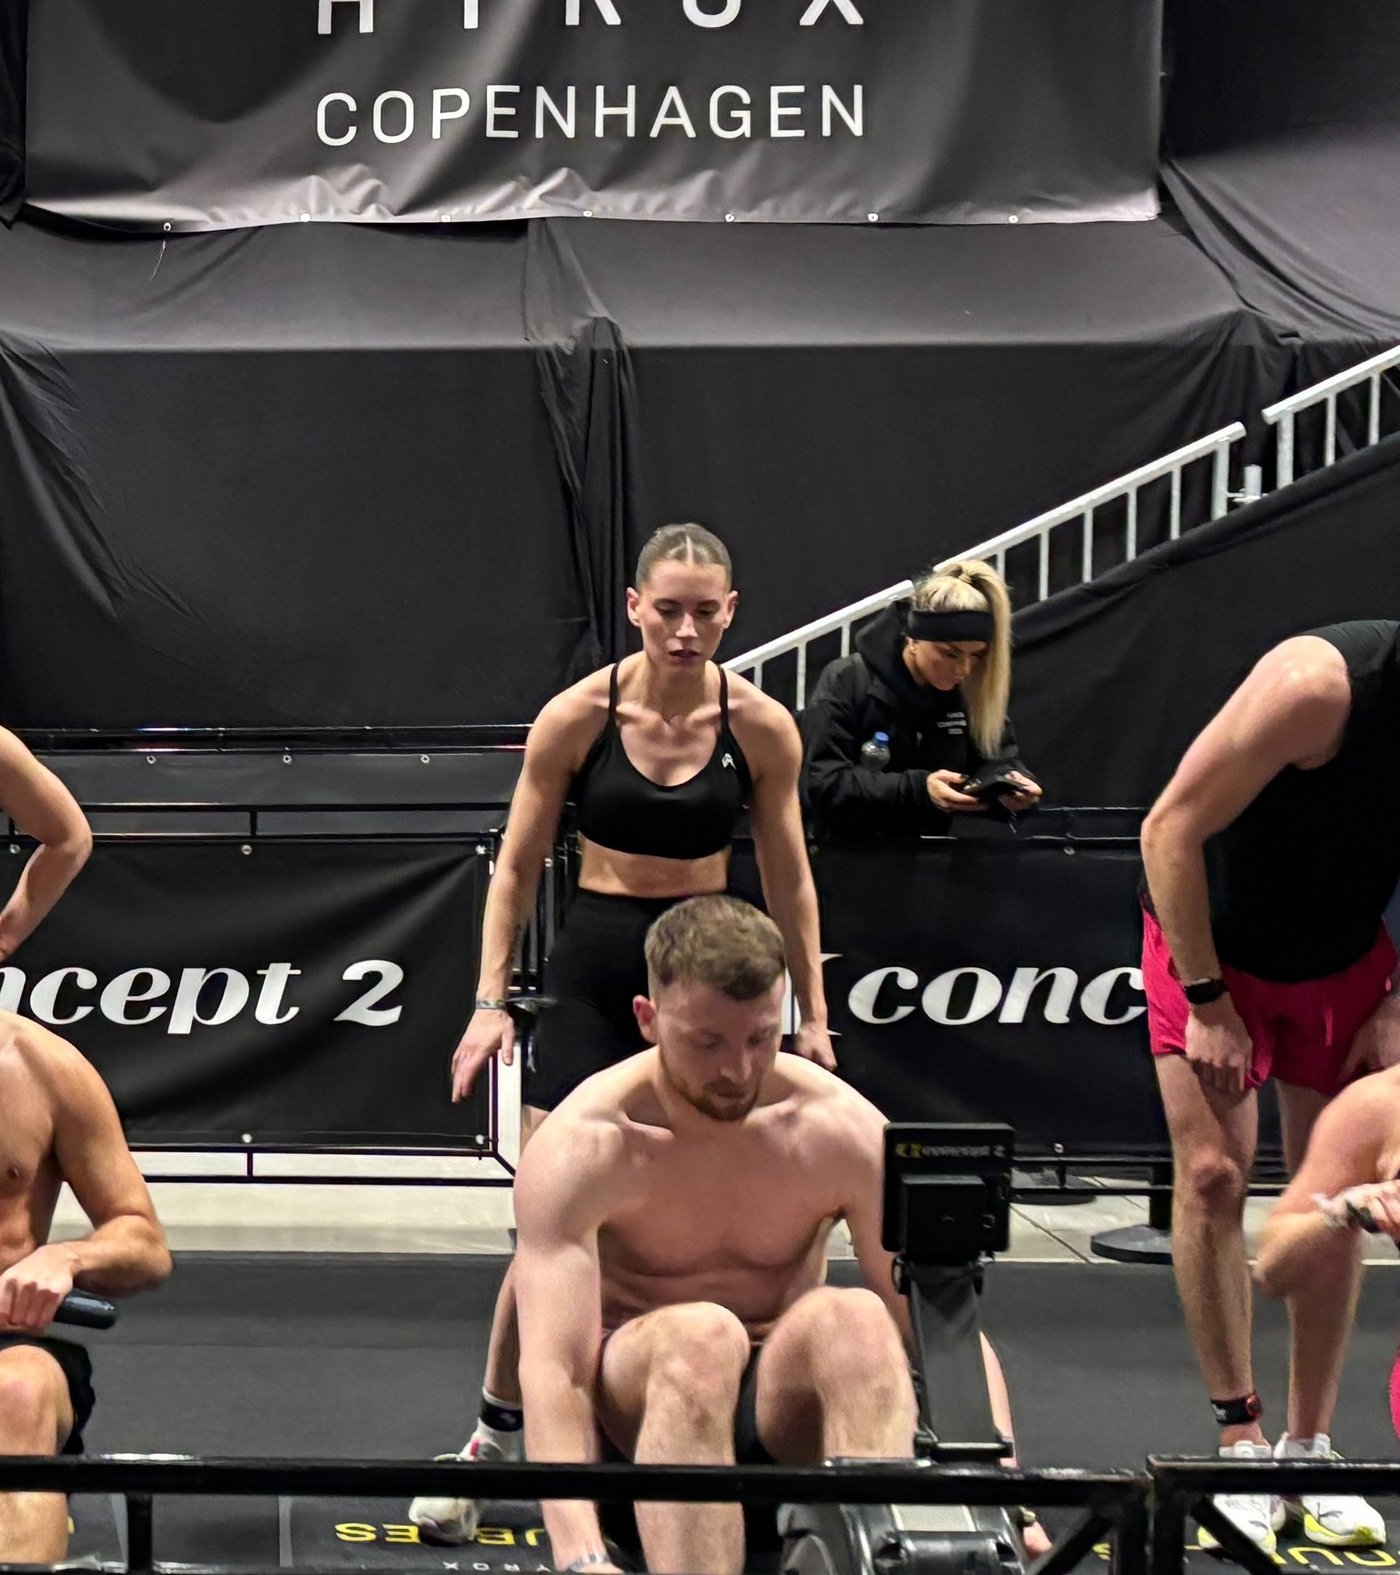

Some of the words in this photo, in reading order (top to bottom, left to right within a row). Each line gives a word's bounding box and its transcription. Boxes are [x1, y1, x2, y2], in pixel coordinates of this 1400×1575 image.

[316, 84, 864, 146] COPENHAGEN
[333, 959, 404, 1027] 2
[847, 966, 1149, 1026] conc
